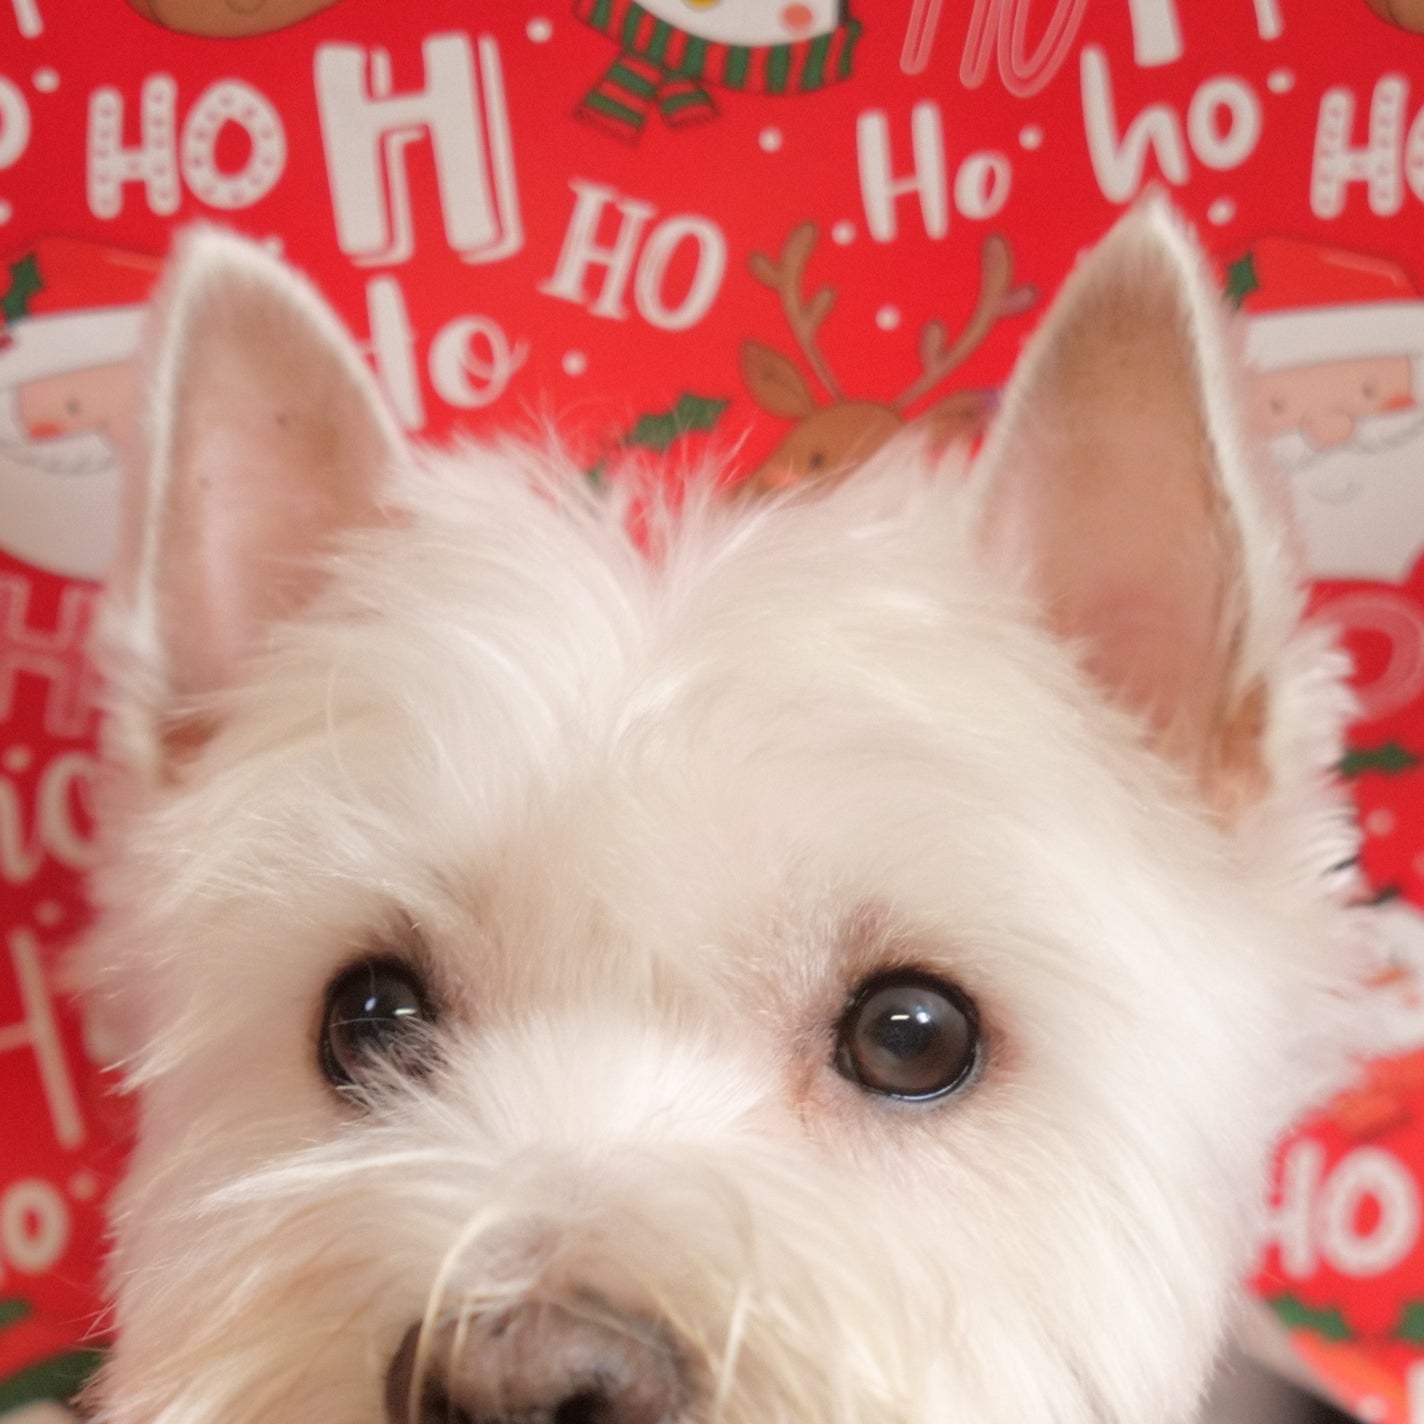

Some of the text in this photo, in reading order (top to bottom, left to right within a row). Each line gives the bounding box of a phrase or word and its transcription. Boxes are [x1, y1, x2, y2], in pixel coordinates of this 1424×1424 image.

[87, 73, 287, 218] HO
[314, 32, 524, 267] H
[856, 101, 1011, 243] Ho
[1080, 44, 1263, 204] ho
[537, 177, 727, 331] HO
